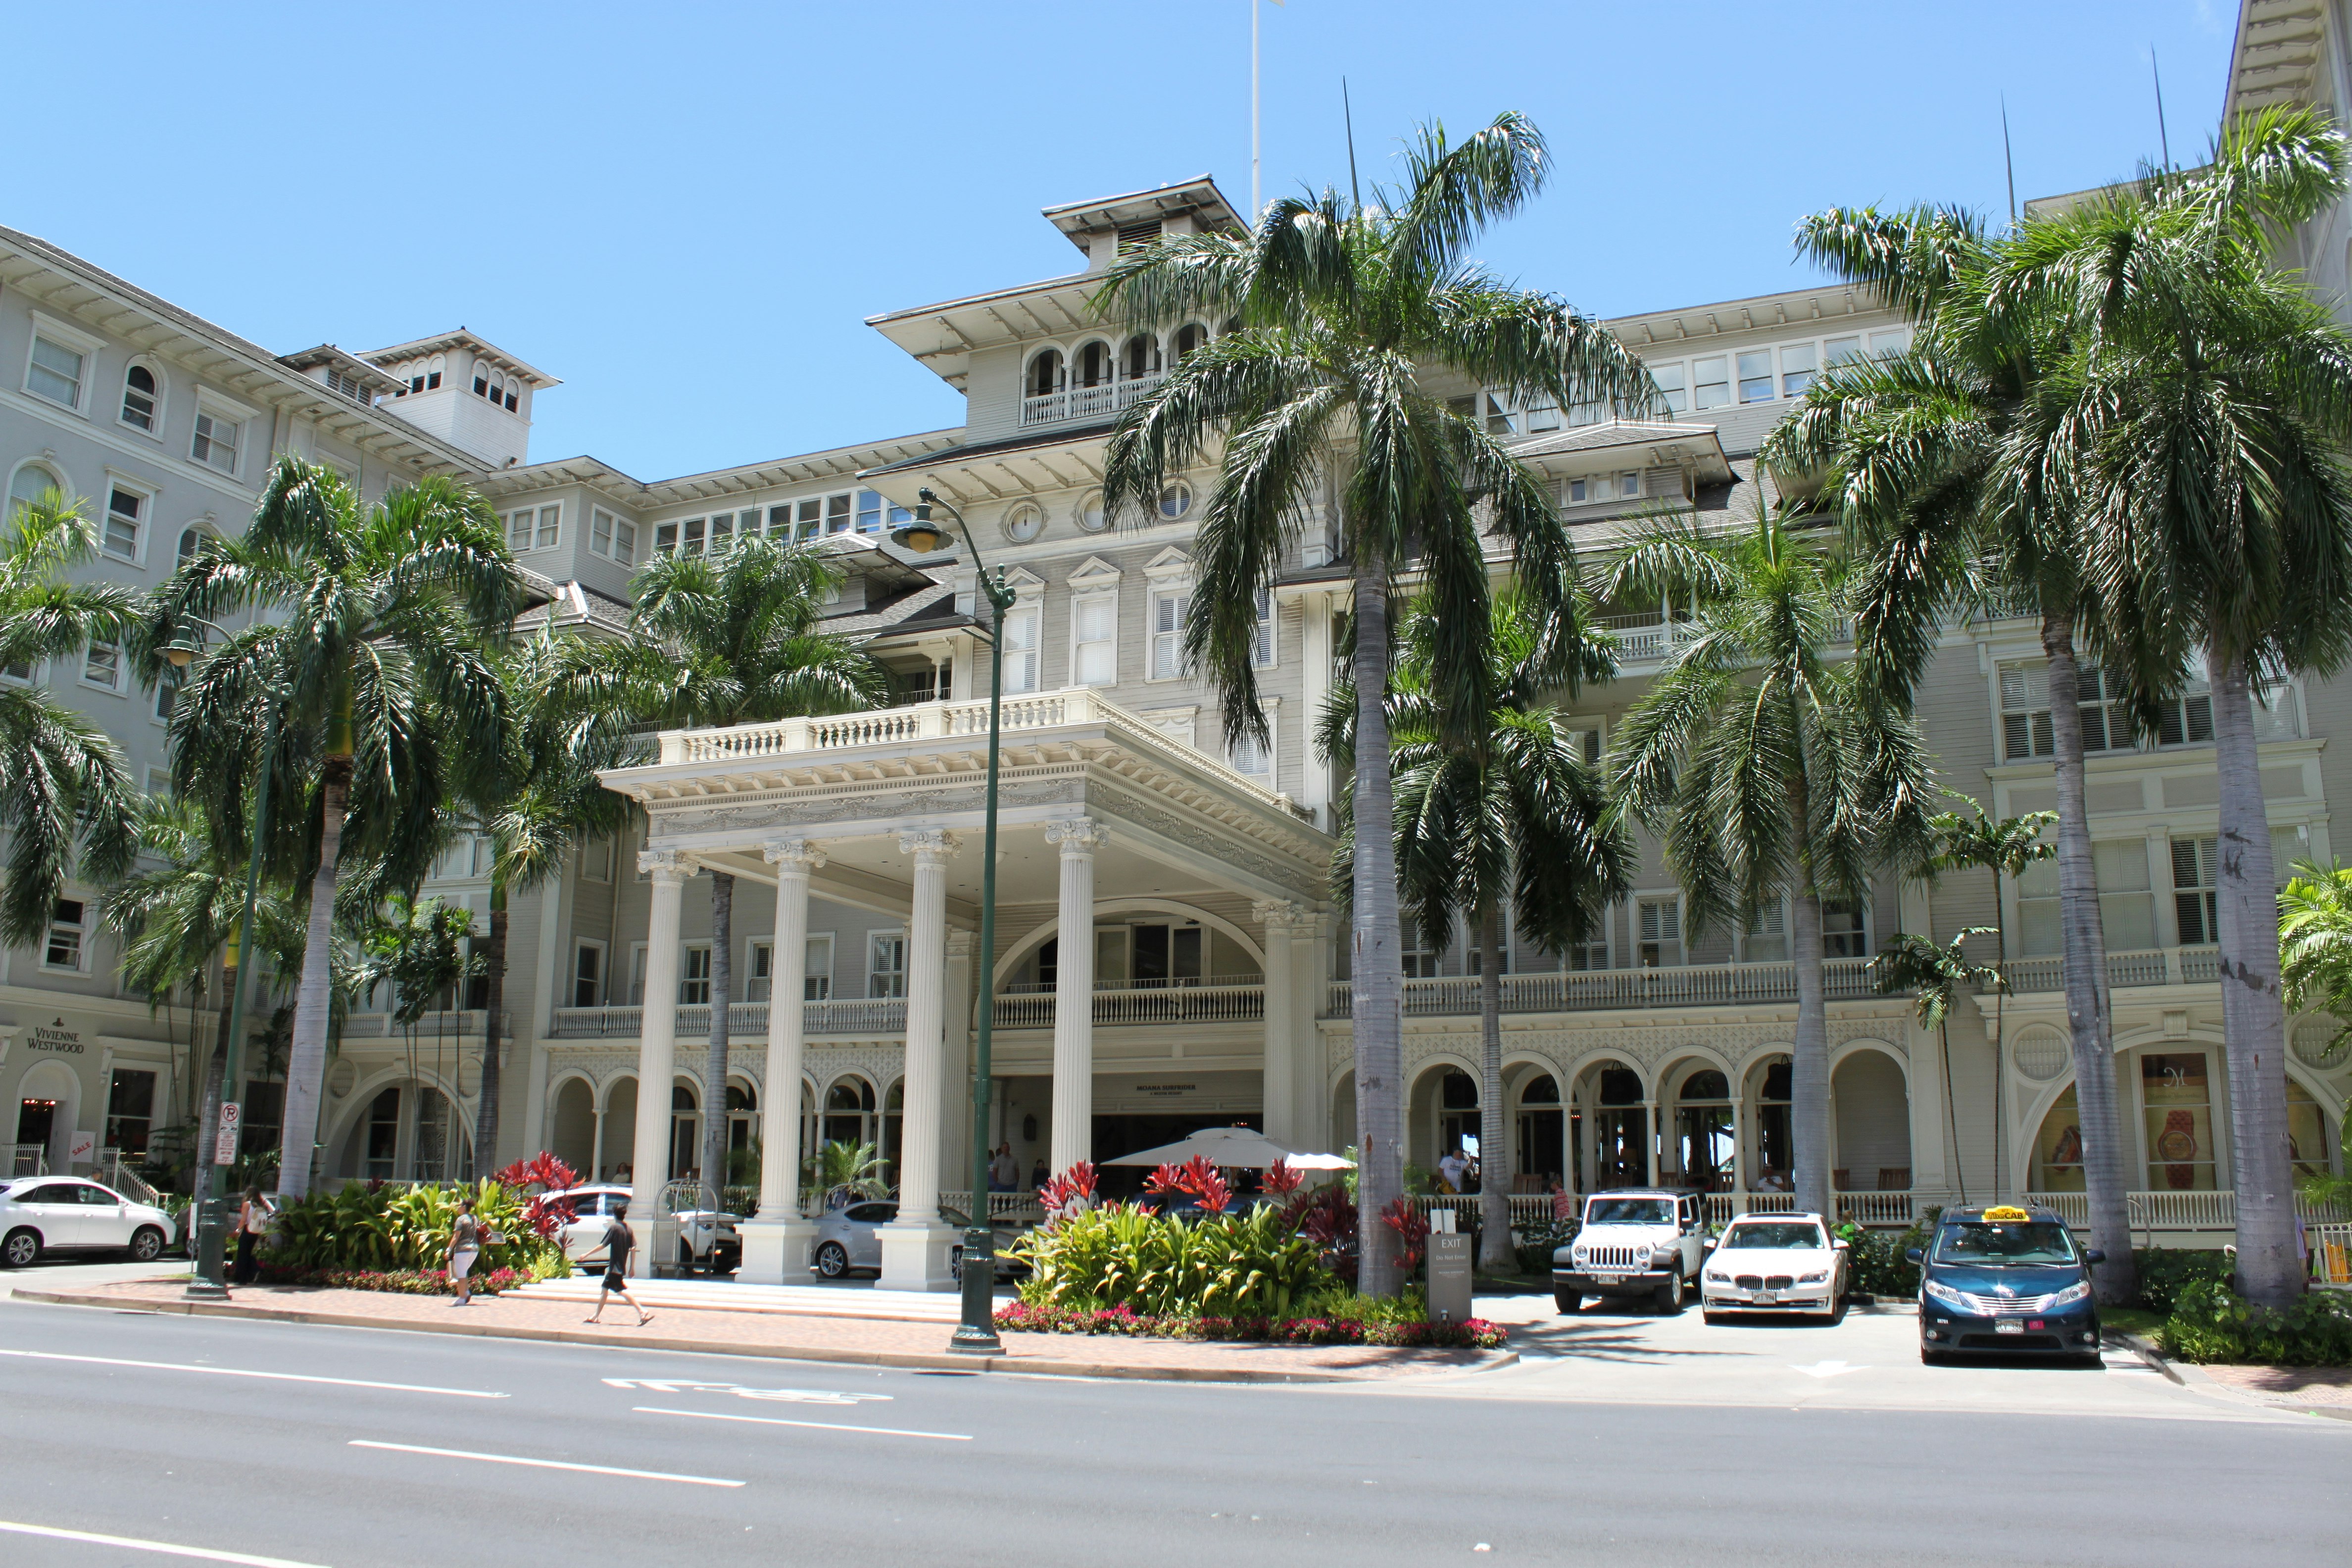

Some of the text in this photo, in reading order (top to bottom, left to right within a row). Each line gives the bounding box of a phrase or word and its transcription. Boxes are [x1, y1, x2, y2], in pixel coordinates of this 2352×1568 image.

[36, 1028, 79, 1042] VIVIENNE
[27, 1038, 84, 1053] WESTWOOD
[72, 1141, 91, 1156] SALE
[1442, 1239, 1461, 1248] EXIT
